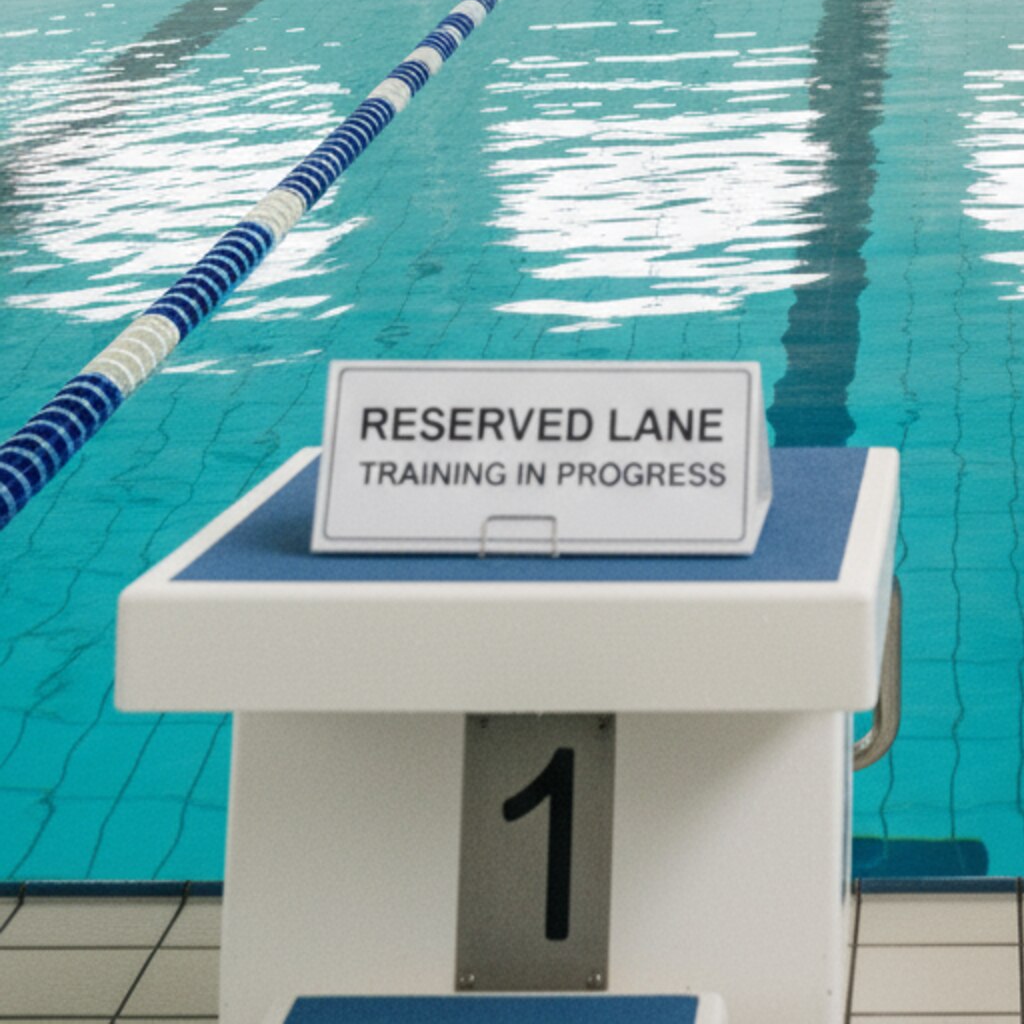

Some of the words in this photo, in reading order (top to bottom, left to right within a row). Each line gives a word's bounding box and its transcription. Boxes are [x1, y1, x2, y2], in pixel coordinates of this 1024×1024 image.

[360, 407, 594, 442] RESERVED
[609, 408, 724, 443] LANE
[359, 461, 507, 487] TRAINING
[517, 462, 547, 487] IN
[557, 462, 727, 488] PROGRESS
[502, 747, 575, 941] 1
